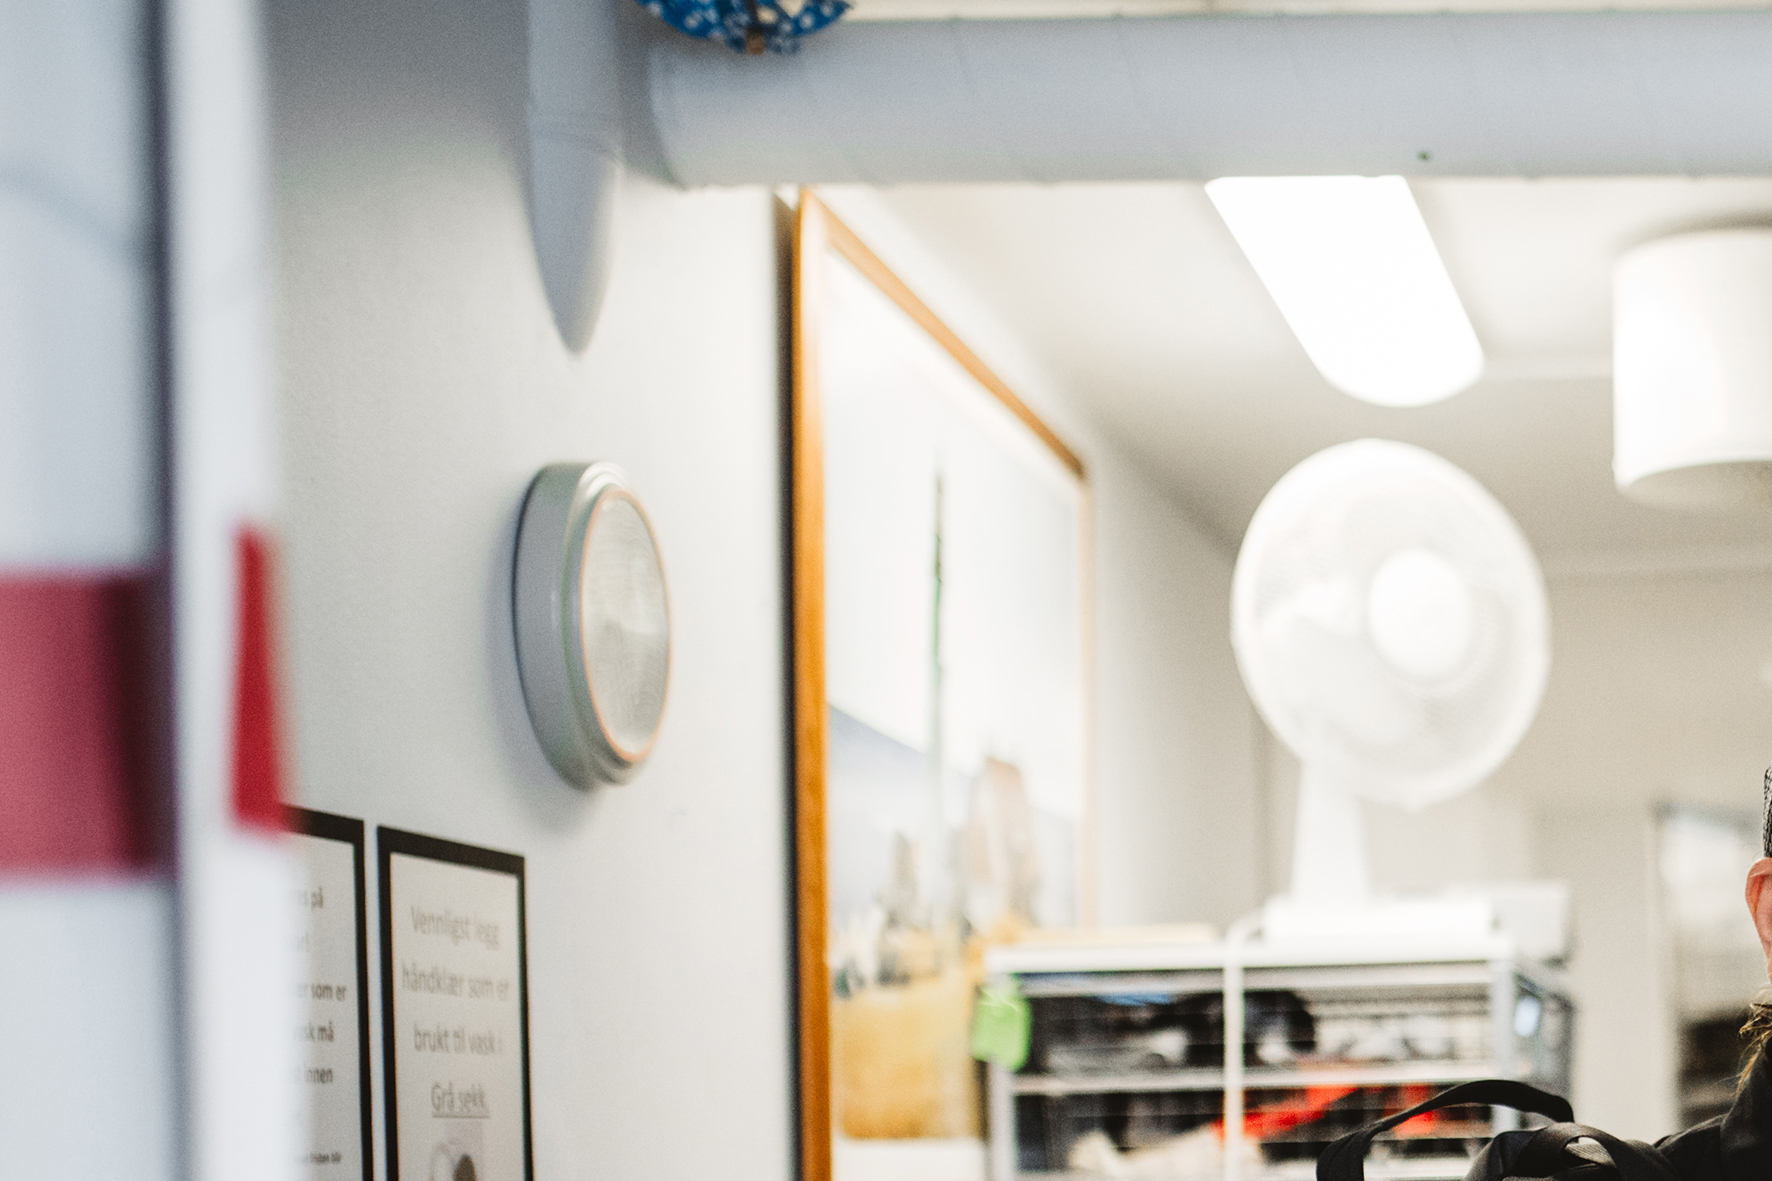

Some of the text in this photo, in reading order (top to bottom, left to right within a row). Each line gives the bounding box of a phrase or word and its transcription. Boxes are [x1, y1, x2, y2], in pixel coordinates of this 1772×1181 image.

[410, 904, 500, 951] Vennligst legg
[311, 982, 333, 1001] som
[335, 984, 347, 1002] er
[402, 960, 510, 1001] håndklær som er
[317, 1019, 335, 1042] må
[413, 1021, 450, 1053] brukt
[453, 1024, 466, 1054] til
[468, 1028, 496, 1056] vask
[431, 1080, 455, 1112] Grå
